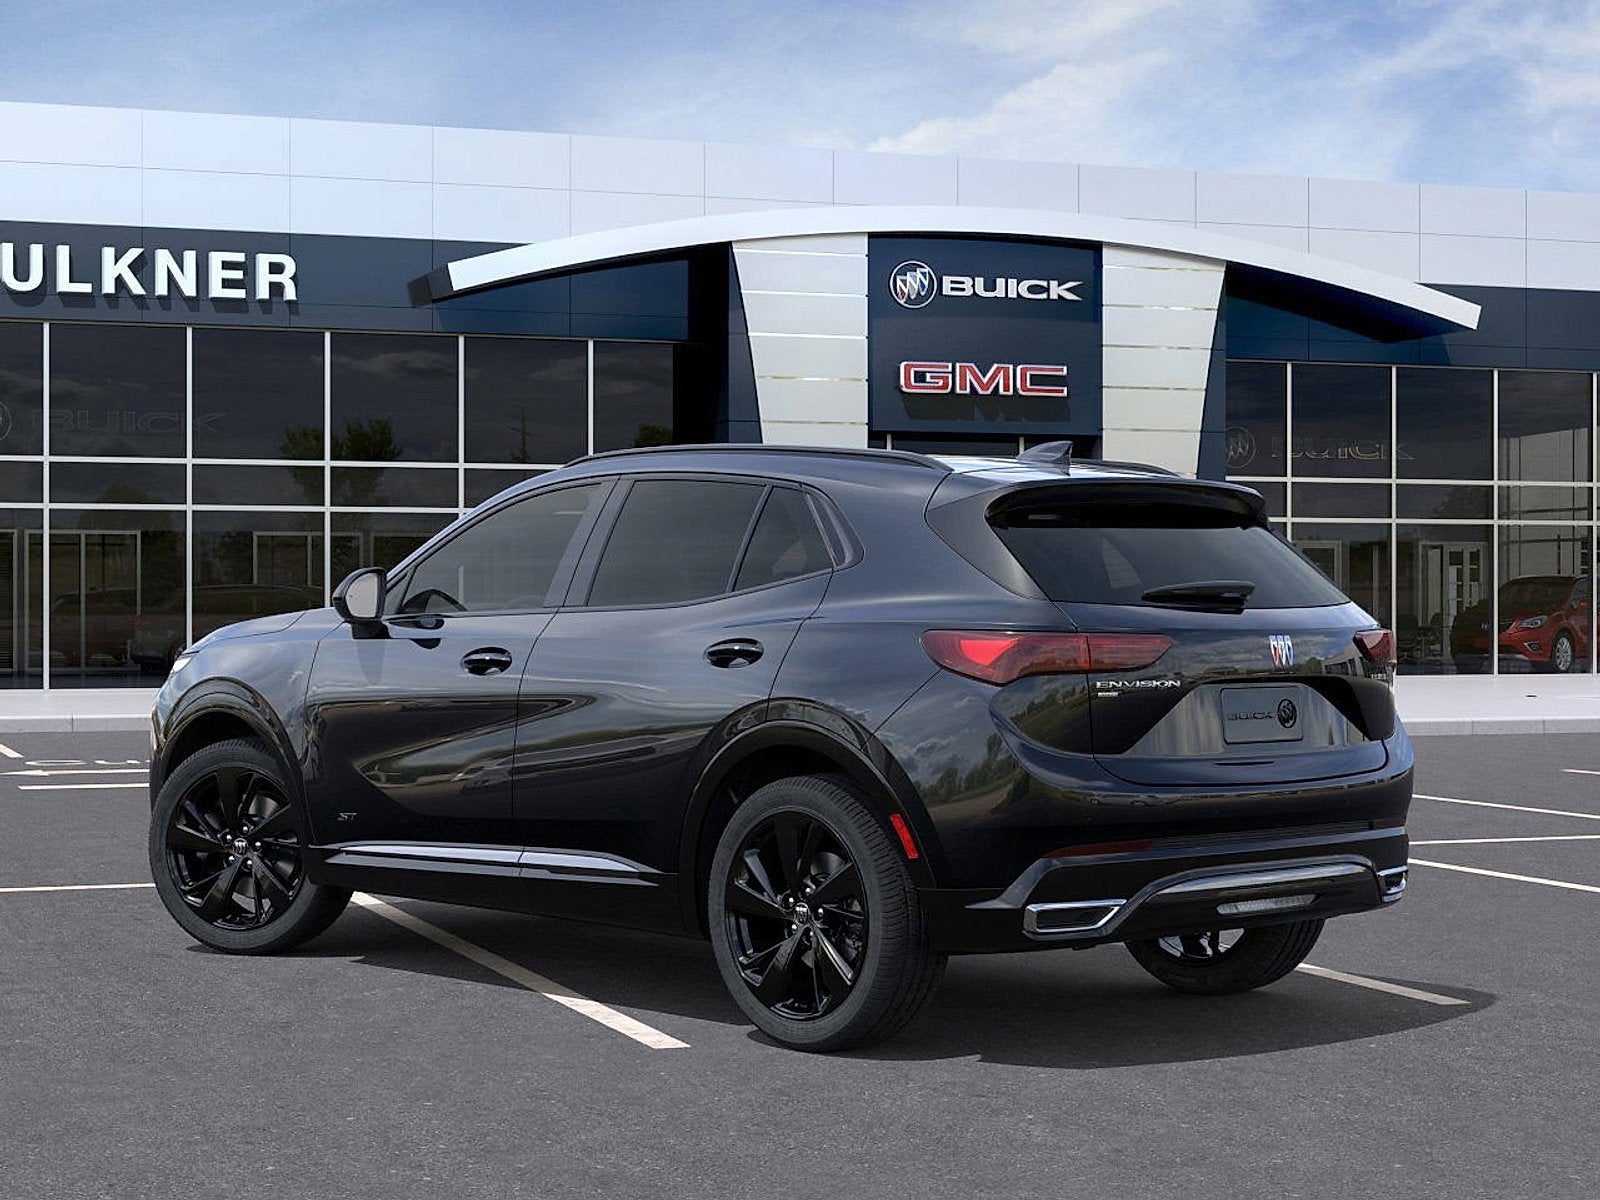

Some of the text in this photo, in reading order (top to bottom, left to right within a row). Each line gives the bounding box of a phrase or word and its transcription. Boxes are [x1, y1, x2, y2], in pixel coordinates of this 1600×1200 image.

[0, 242, 298, 301] ULKNER
[941, 275, 1084, 300] BUICK
[900, 361, 1068, 397] GMC
[1096, 680, 1181, 689] ENVISION
[1227, 711, 1275, 721] BUICK
